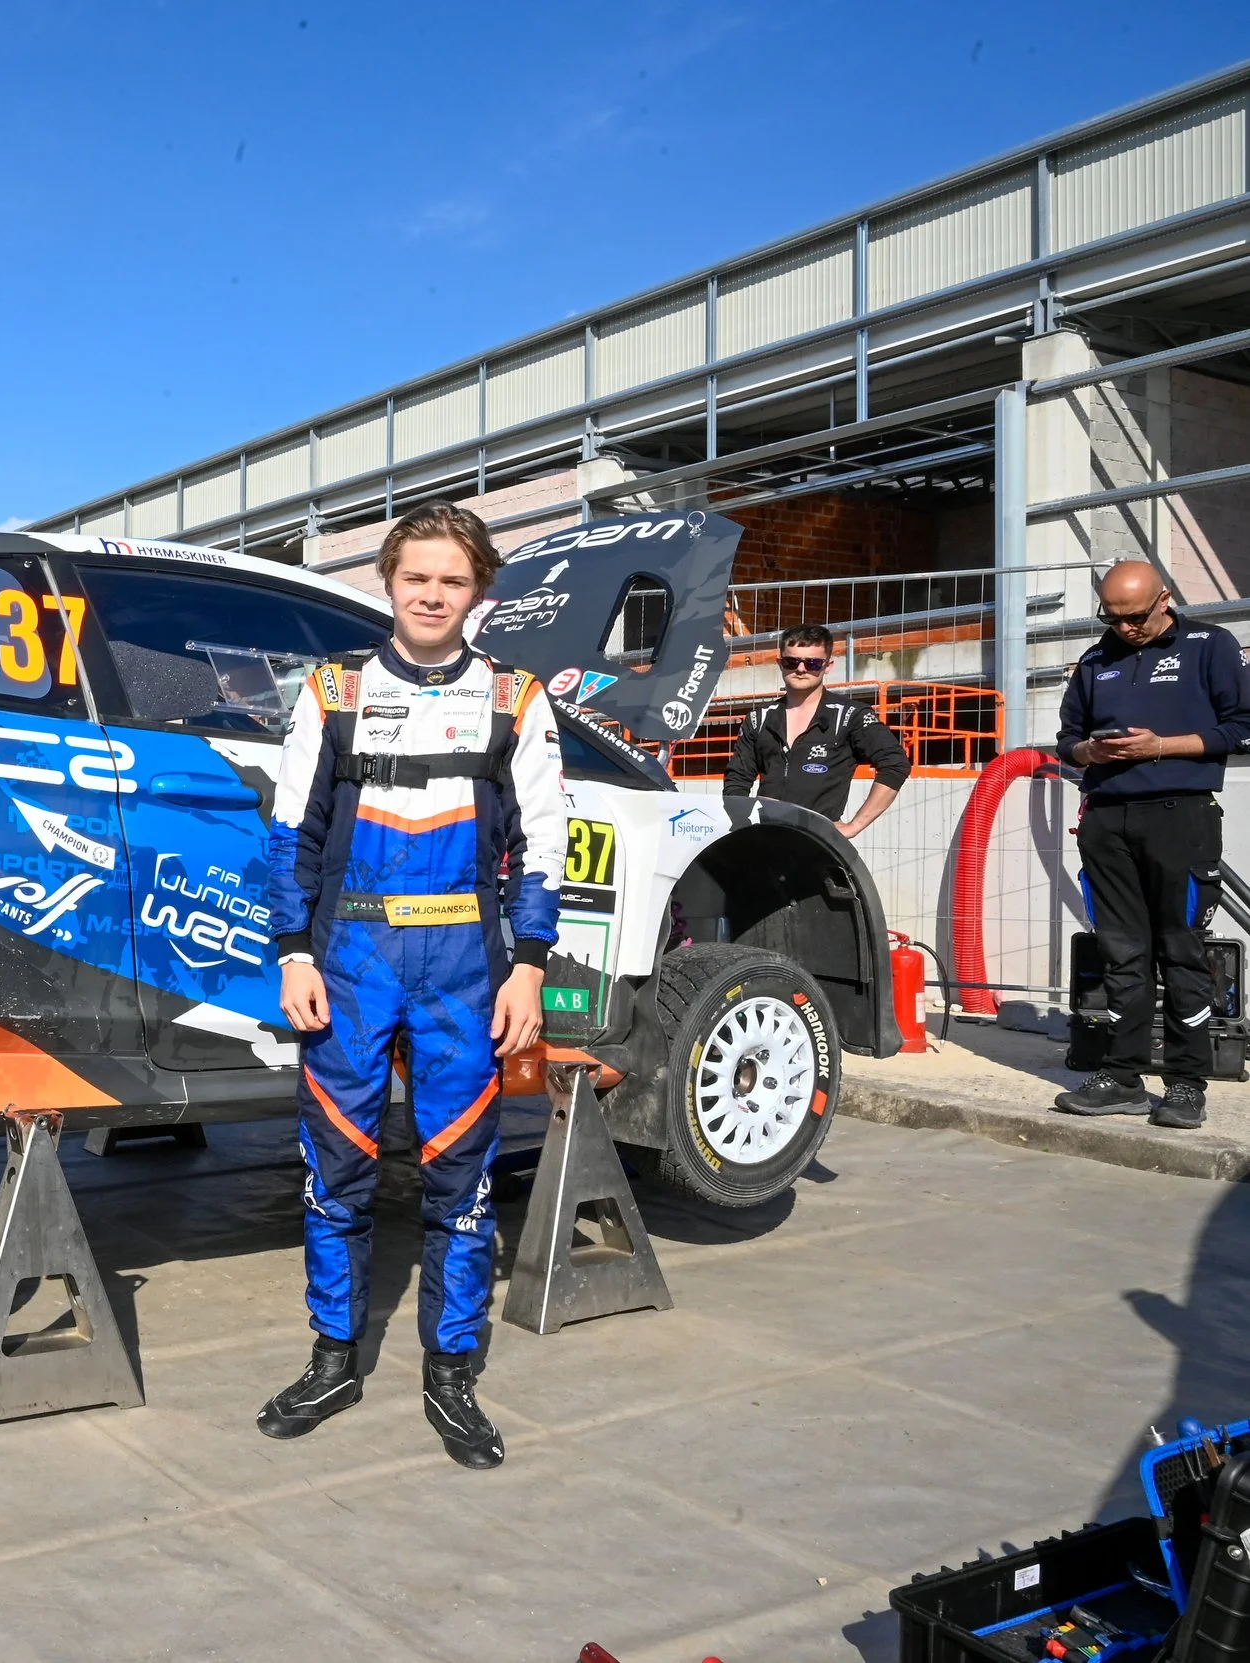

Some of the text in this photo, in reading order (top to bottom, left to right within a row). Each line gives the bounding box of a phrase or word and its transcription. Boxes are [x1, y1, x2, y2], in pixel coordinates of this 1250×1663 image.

[136, 546, 227, 565] HYRMASKINER
[504, 624, 525, 632] FIA
[677, 644, 715, 702] Forss IT
[343, 674, 356, 708] SIMPSON
[367, 690, 402, 699] WRC
[443, 689, 486, 698] WRC
[497, 676, 509, 709] SIMPSON
[42, 819, 89, 854] CHAMPION
[677, 822, 714, 836] Sjötorps
[566, 819, 614, 884] 37
[207, 865, 241, 888] FIA
[161, 875, 271, 926] JUNIOR
[411, 904, 477, 915] M.JOHANSSON
[140, 893, 270, 966] WRC
[554, 992, 583, 1009] A B
